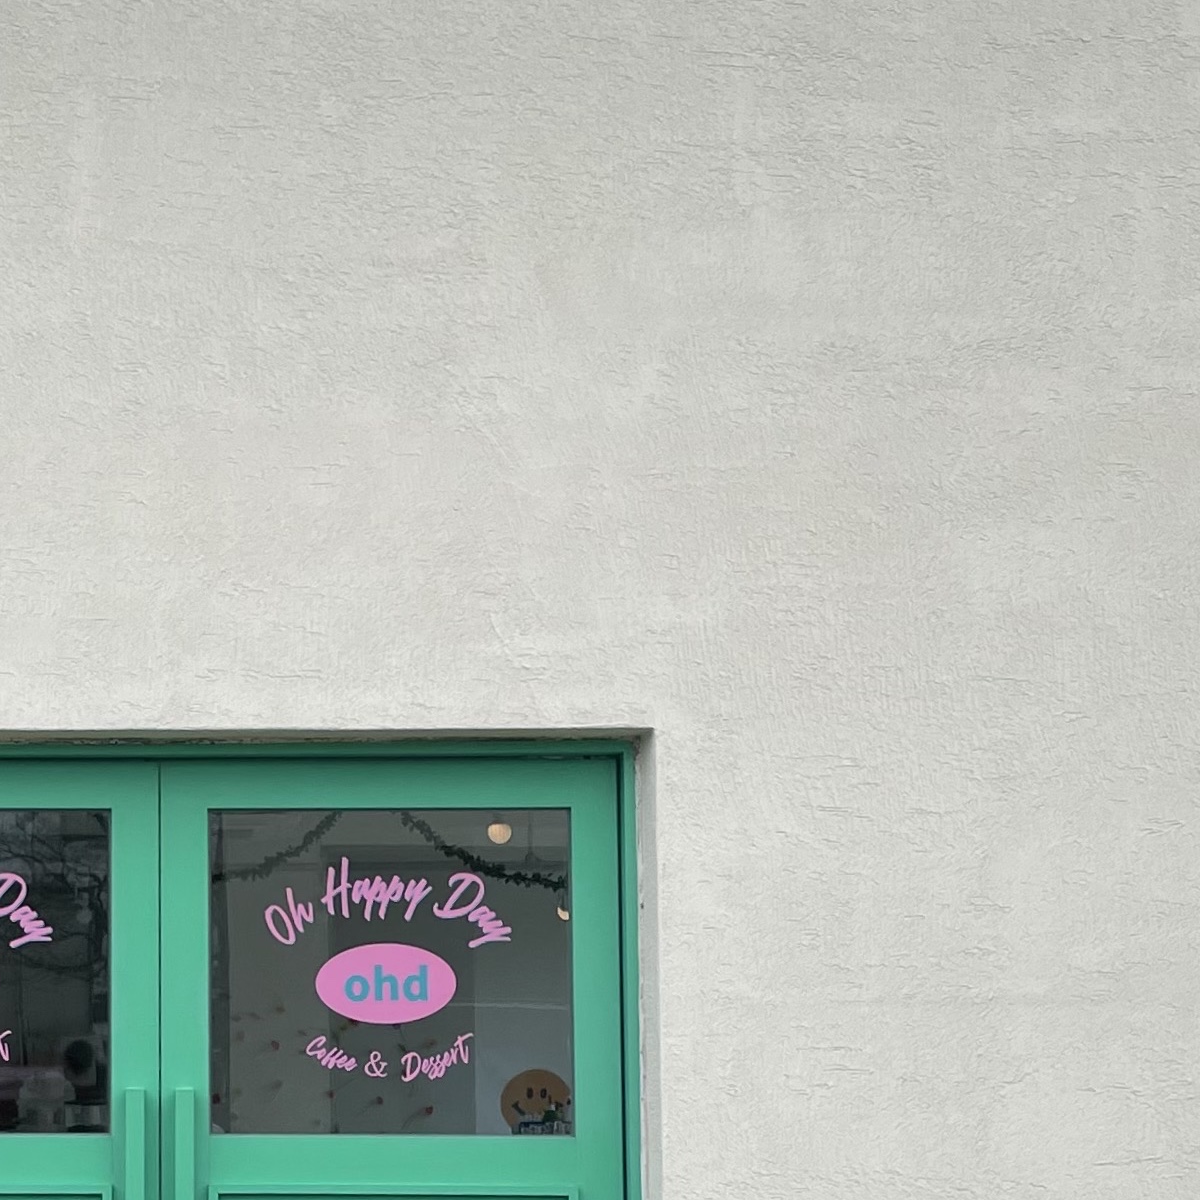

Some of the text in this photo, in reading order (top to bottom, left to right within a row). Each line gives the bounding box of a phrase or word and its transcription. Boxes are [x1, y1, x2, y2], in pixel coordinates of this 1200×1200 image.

[264, 856, 513, 949] Oh Happy Day
[343, 964, 429, 1003] ohd
[305, 1032, 475, 1083] Coffee & Dessert
